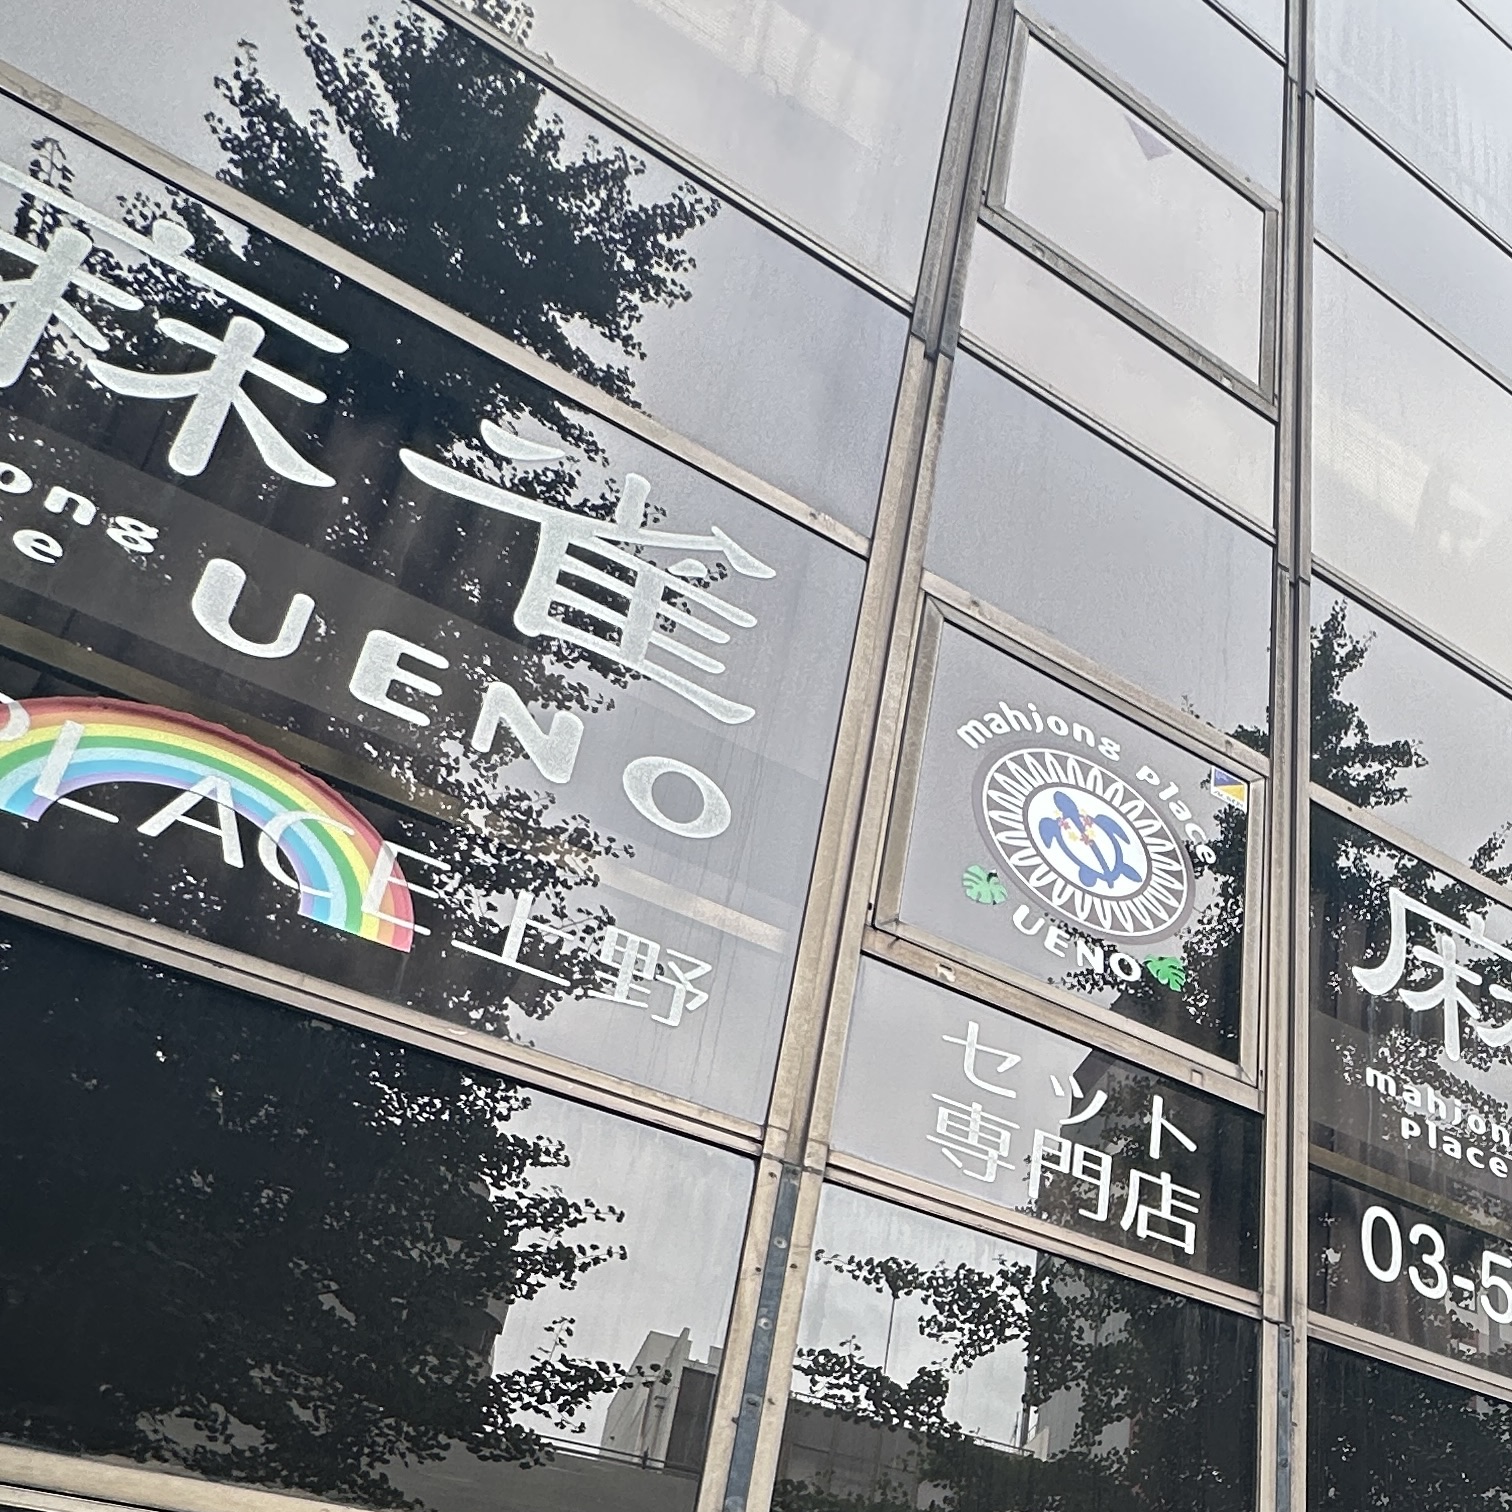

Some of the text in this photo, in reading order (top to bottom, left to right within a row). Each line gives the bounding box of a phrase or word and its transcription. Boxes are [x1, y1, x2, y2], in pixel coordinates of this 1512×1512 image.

[0, 165, 776, 725] 麻雀
[190, 557, 732, 840] UENO
[955, 698, 1218, 868] mahjong place
[450, 890, 715, 1028] 上野
[1011, 902, 1140, 984] UENO
[941, 1020, 1199, 1158] セット
[1400, 1117, 1508, 1182] place
[924, 1090, 1203, 1256] 専門店
